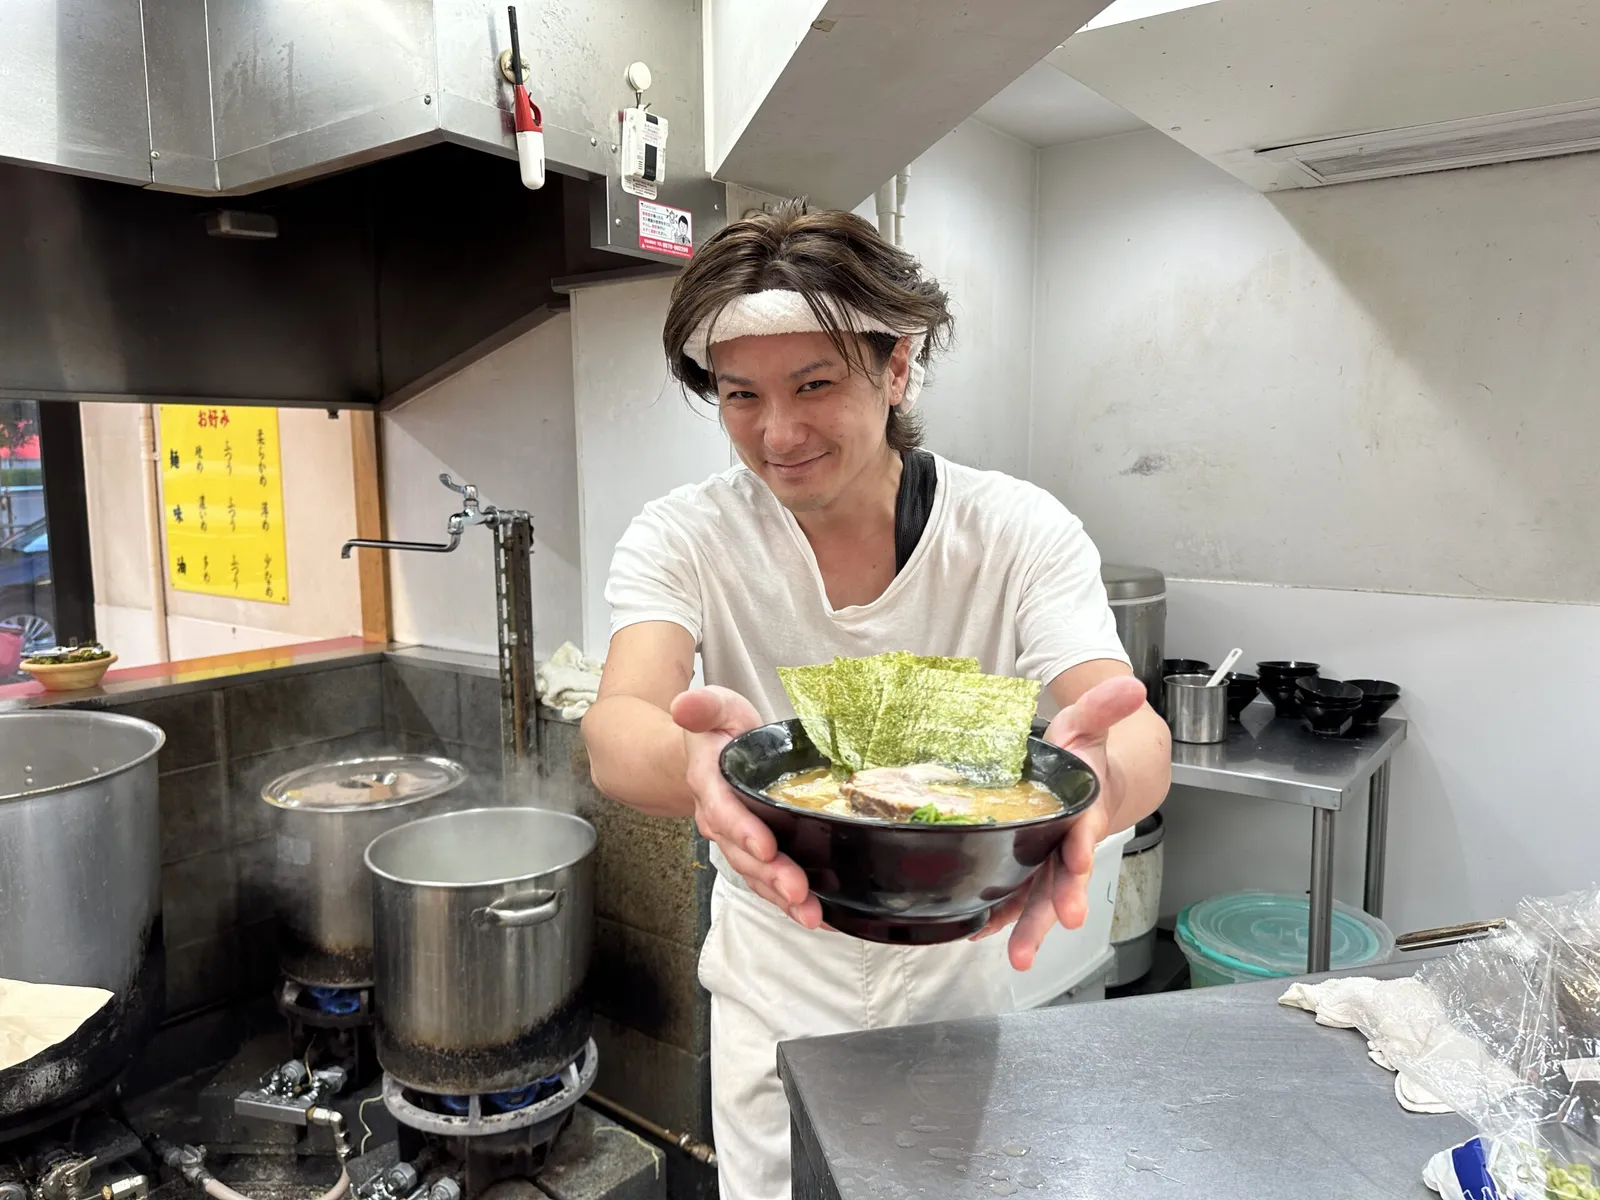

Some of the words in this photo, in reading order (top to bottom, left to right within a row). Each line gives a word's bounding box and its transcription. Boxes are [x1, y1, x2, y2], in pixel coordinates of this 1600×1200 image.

[198, 409, 229, 428] お好み
[224, 440, 232, 476] ふつう
[173, 504, 184, 524] 味
[228, 496, 236, 532] ふつう
[230, 554, 239, 590] ふつう
